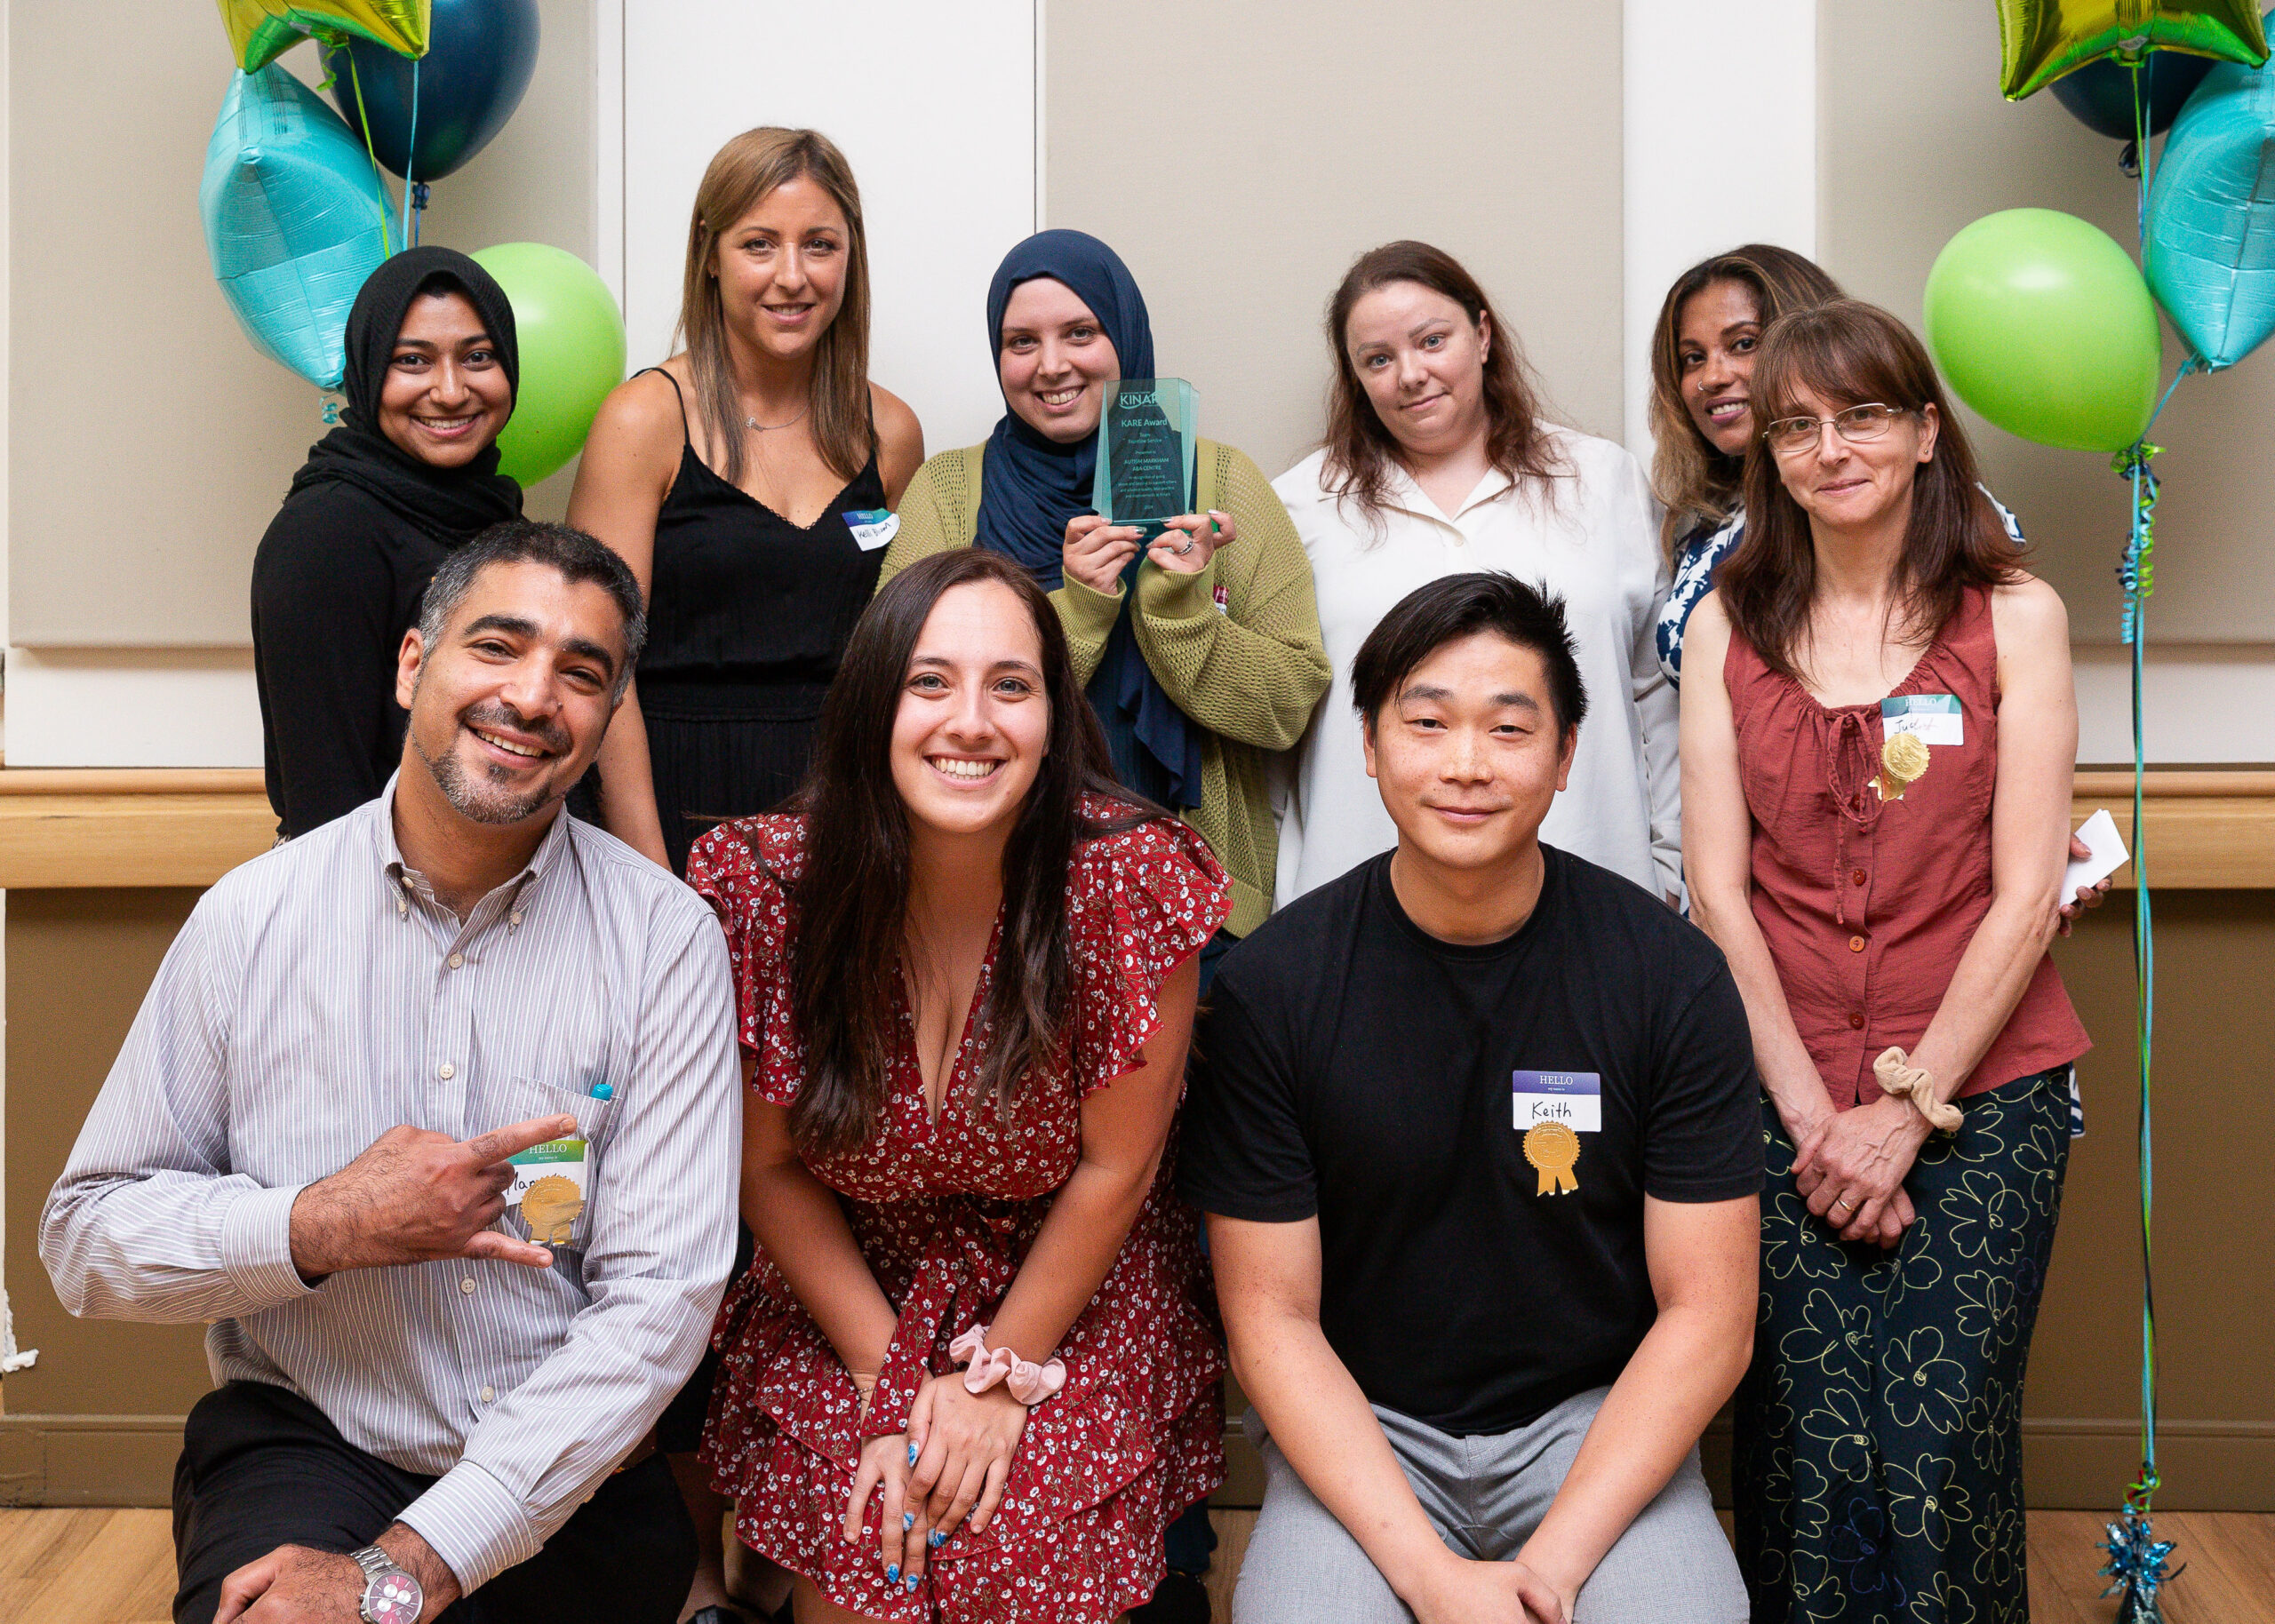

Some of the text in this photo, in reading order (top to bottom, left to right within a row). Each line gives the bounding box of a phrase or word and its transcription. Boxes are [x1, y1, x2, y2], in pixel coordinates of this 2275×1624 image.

[1905, 697, 1937, 707] HELLO
[1540, 1075, 1574, 1086] HELLO
[1532, 1101, 1572, 1119] Keith
[529, 1143, 568, 1154] HELLO
